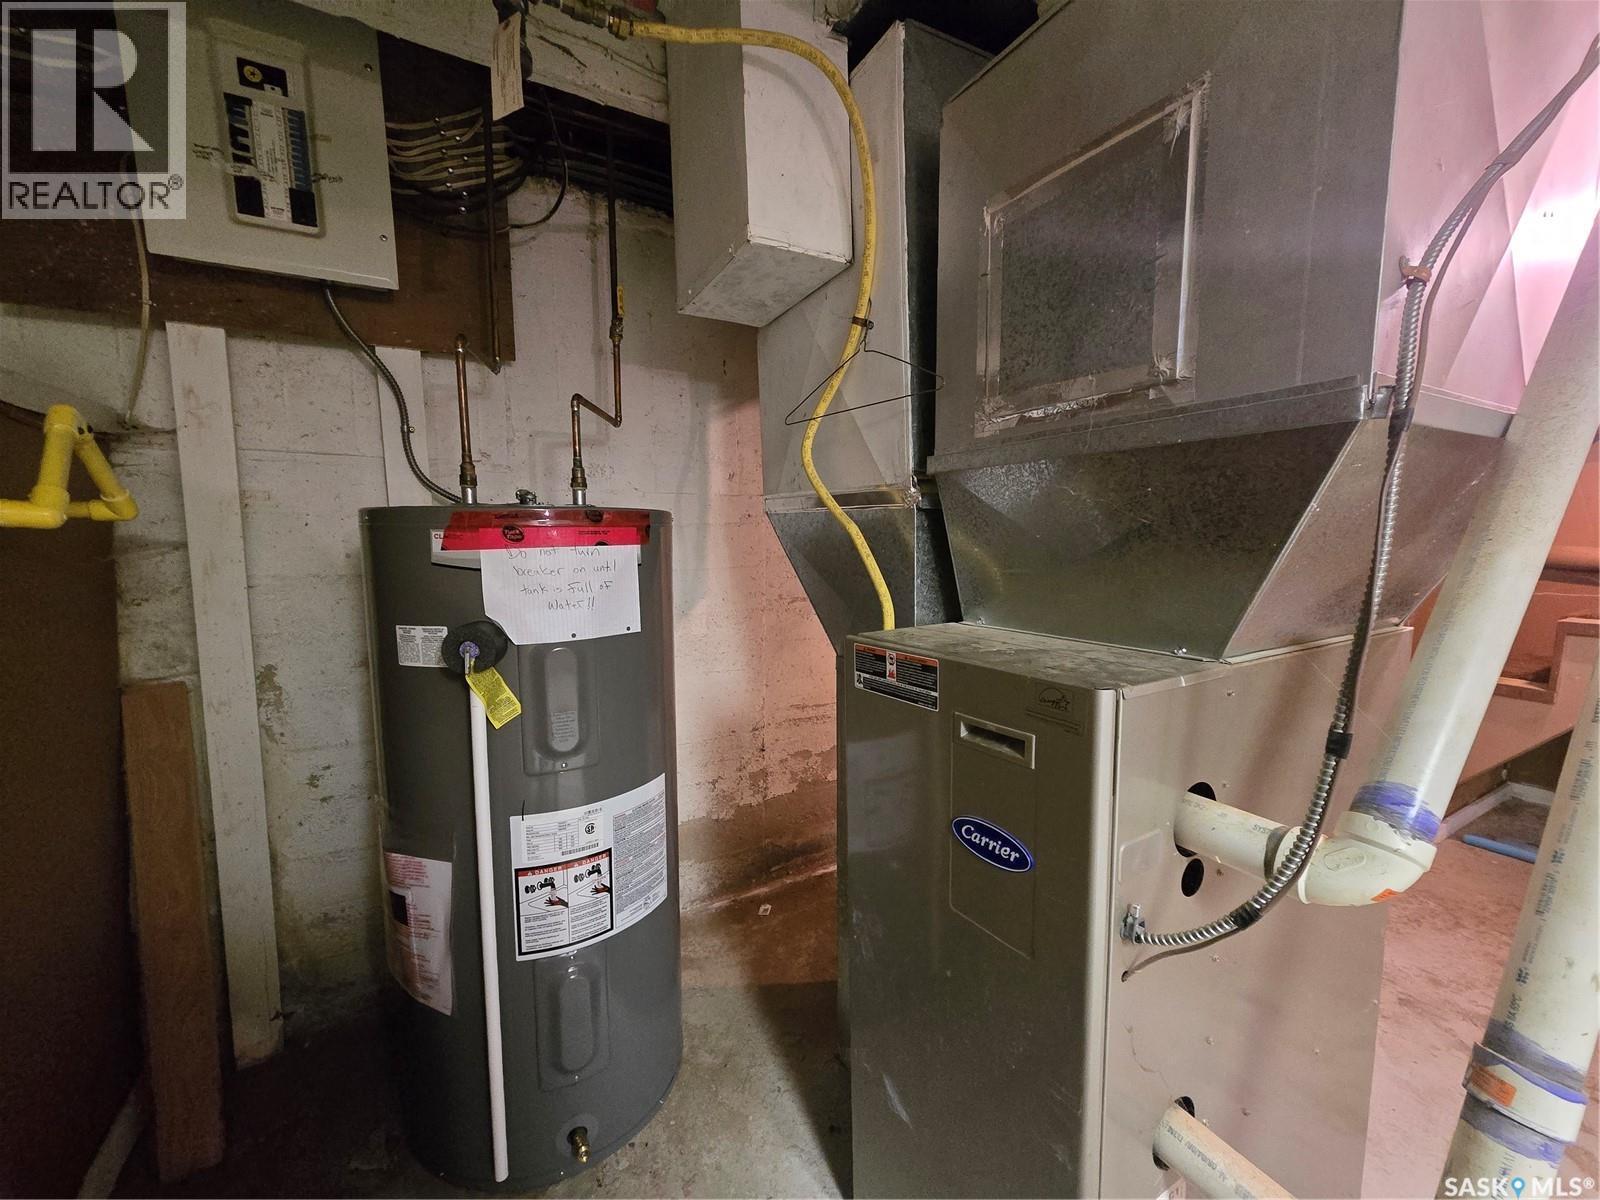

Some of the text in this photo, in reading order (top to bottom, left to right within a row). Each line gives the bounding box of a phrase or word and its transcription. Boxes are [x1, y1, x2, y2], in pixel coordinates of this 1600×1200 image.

[505, 544, 600, 560] Do not turn
[513, 564, 565, 577] breaker
[593, 560, 616, 573] until
[520, 583, 548, 596] tank
[961, 824, 1020, 862] Carrier
[582, 853, 607, 865] DANGER
[535, 866, 562, 875] DANGER
